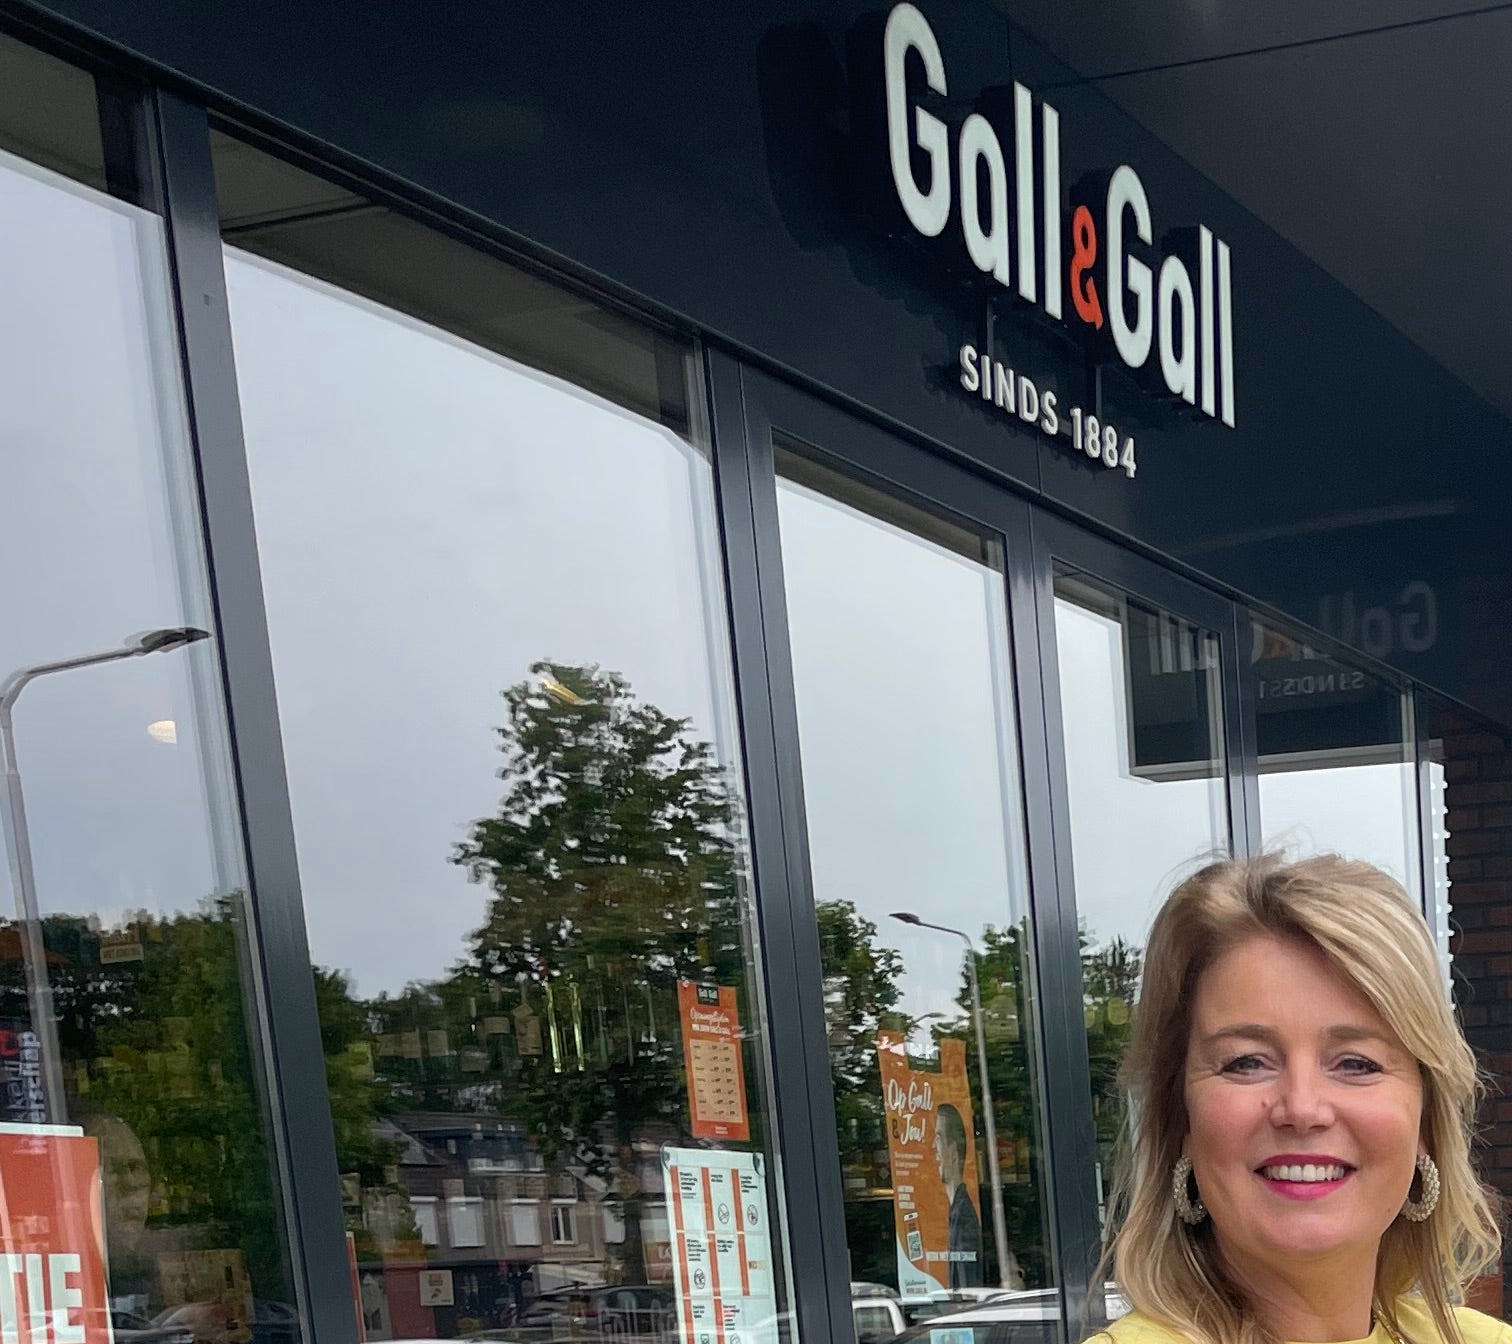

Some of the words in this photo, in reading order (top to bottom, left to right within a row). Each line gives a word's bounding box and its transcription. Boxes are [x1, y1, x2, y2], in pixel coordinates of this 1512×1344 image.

[960, 345, 1058, 435] SINDS
[1070, 407, 1136, 478] 1884
[888, 1079, 907, 1116] Op
[908, 1081, 933, 1113] Gall
